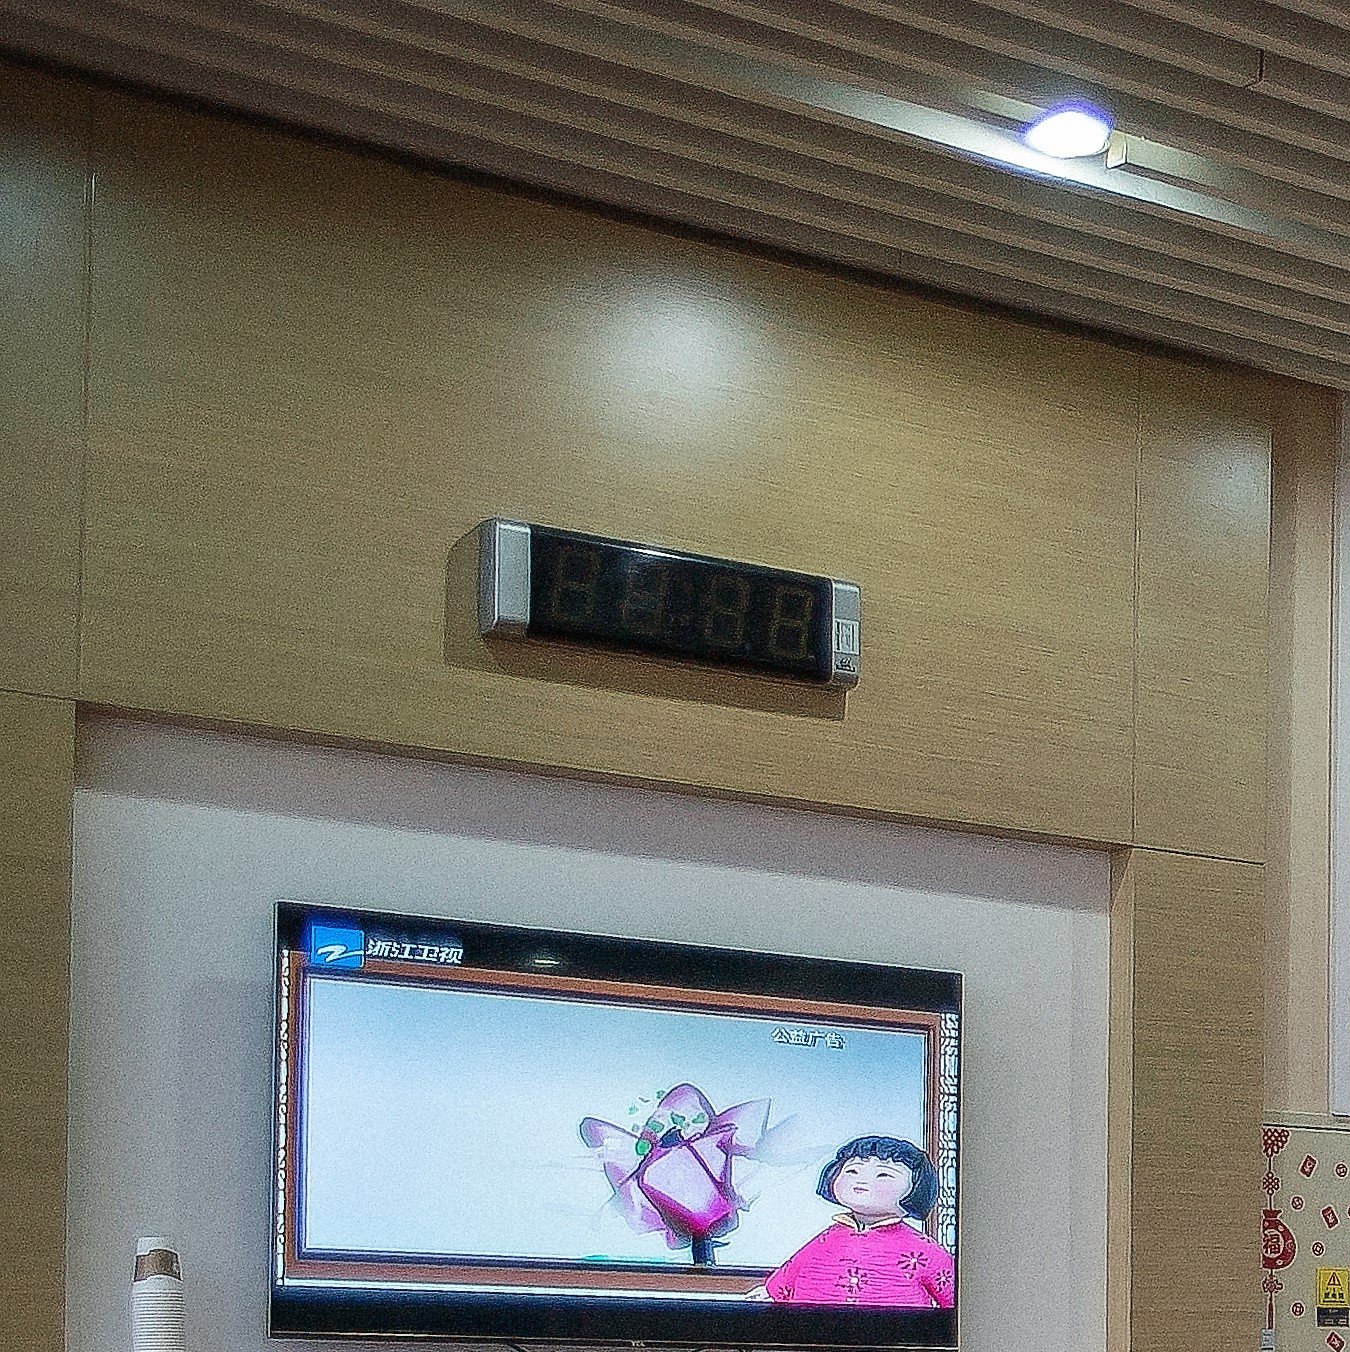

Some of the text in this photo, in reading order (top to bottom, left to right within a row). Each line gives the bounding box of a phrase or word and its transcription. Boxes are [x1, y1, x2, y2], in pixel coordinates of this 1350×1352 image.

[366, 938, 464, 964] 浙江卫视
[771, 1027, 845, 1049] 公益广告
[1263, 1231, 1281, 1255] 福
